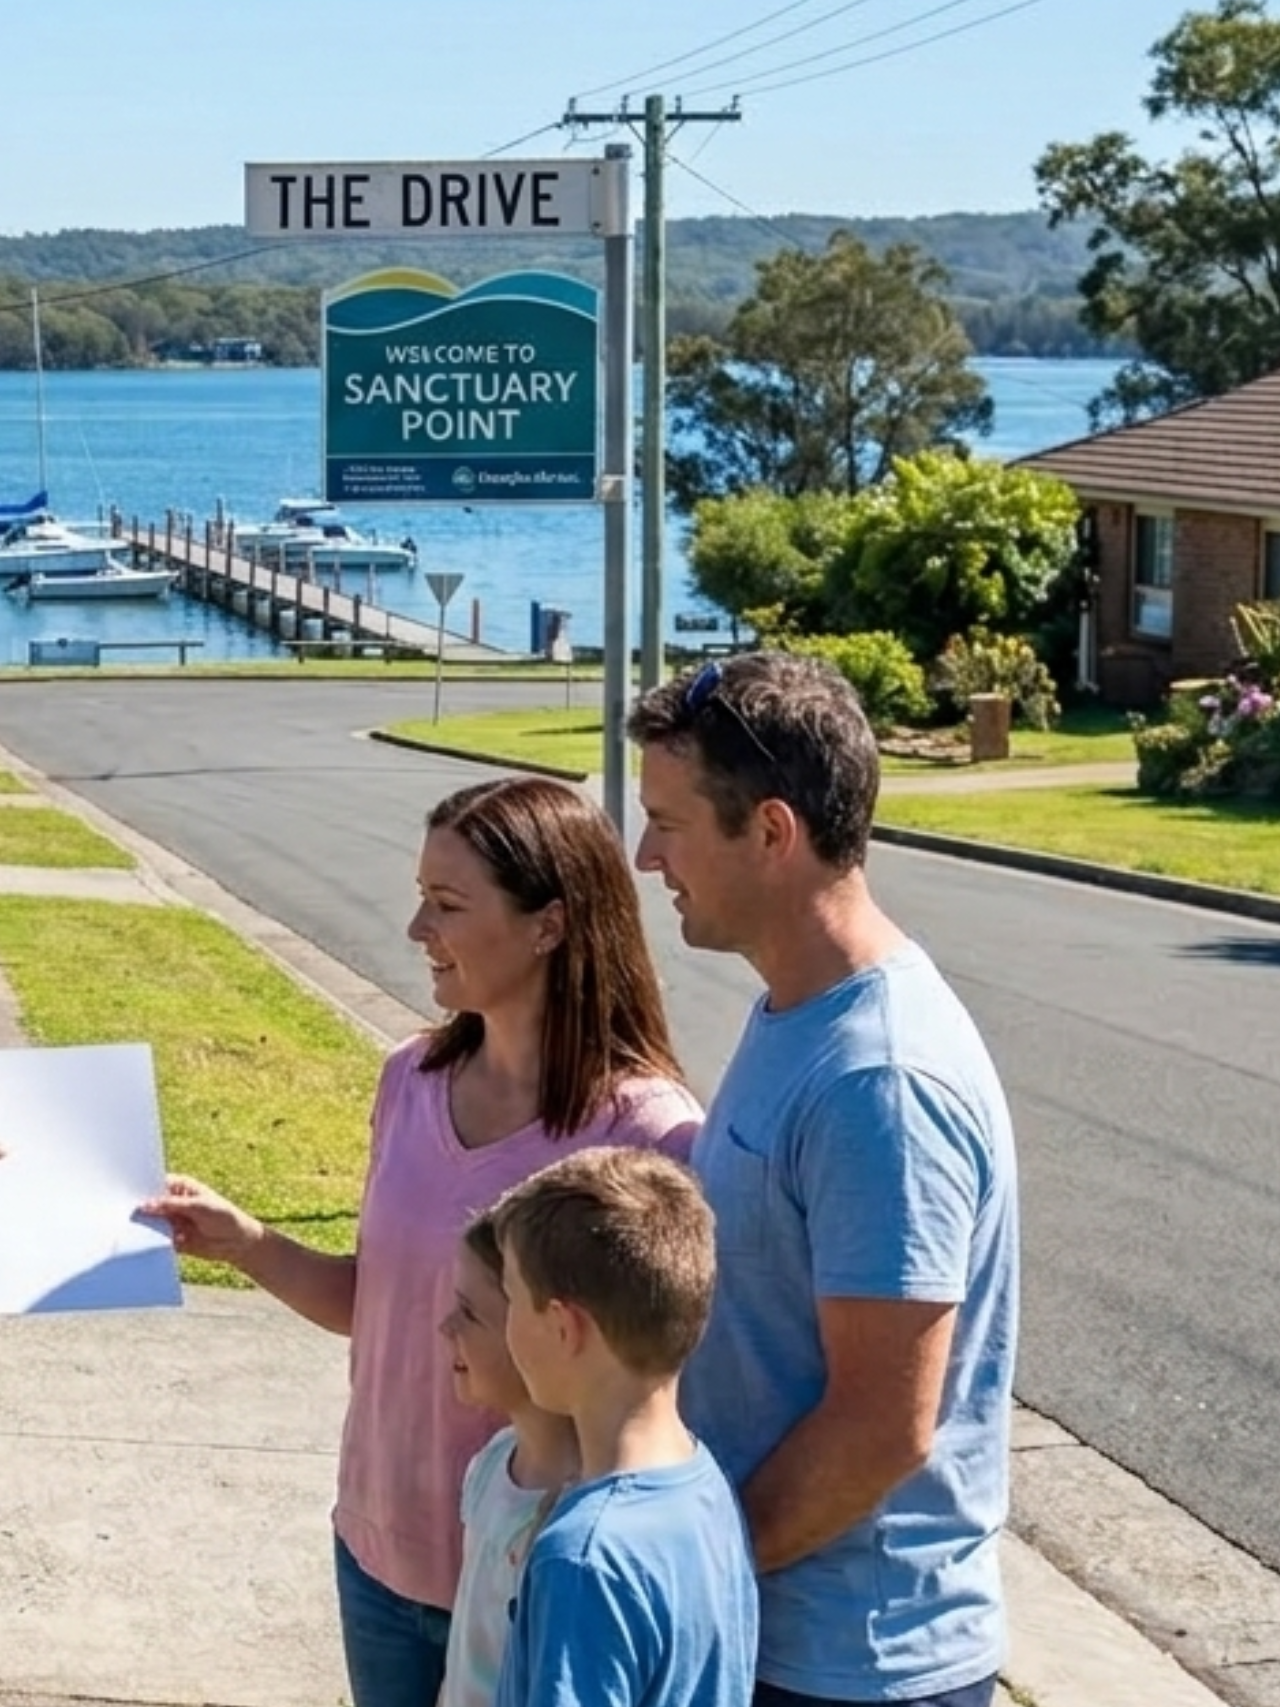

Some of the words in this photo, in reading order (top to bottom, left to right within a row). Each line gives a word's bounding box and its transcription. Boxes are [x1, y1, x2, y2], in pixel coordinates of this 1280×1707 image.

[270, 174, 370, 229] THE
[402, 172, 561, 227] DRIVE
[504, 344, 535, 363] TO
[344, 372, 577, 404] SANCTUARY
[402, 409, 520, 440] POINT
